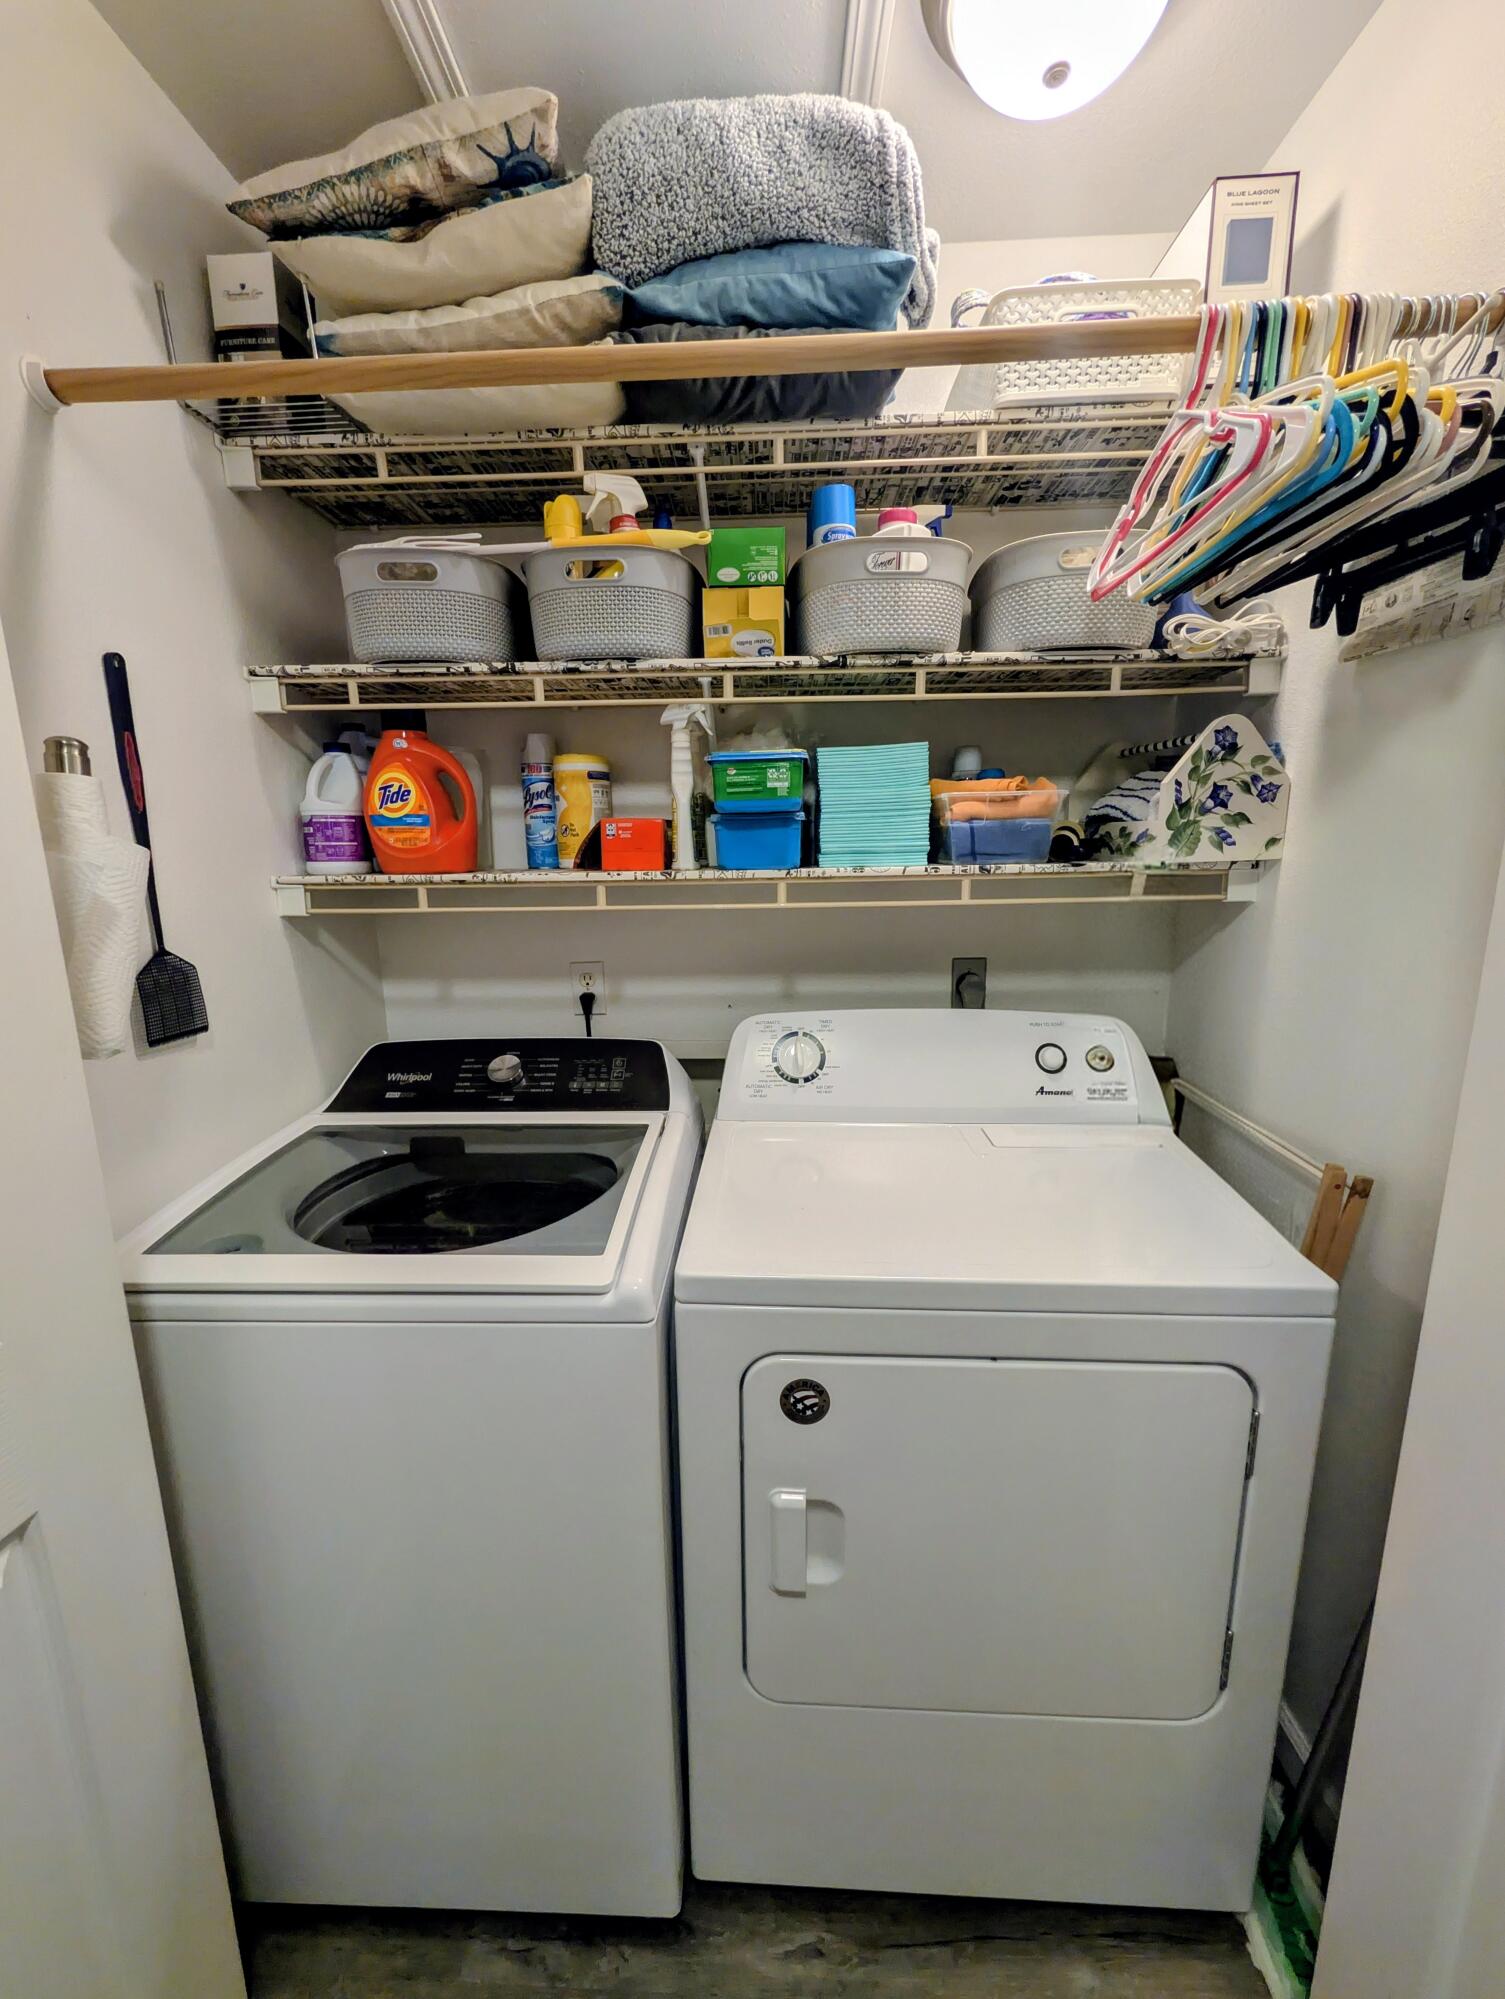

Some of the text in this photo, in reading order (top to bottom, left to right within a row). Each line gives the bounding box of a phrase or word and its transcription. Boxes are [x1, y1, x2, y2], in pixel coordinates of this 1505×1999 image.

[1248, 188, 1280, 196] LAGOON
[220, 336, 276, 347] FURNITURE CARE
[378, 784, 412, 810] Tide
[524, 784, 553, 807] Lysol
[387, 1072, 433, 1083] Whirlpool
[1035, 1086, 1073, 1096] Amana
[783, 1380, 825, 1400] AMERICA
